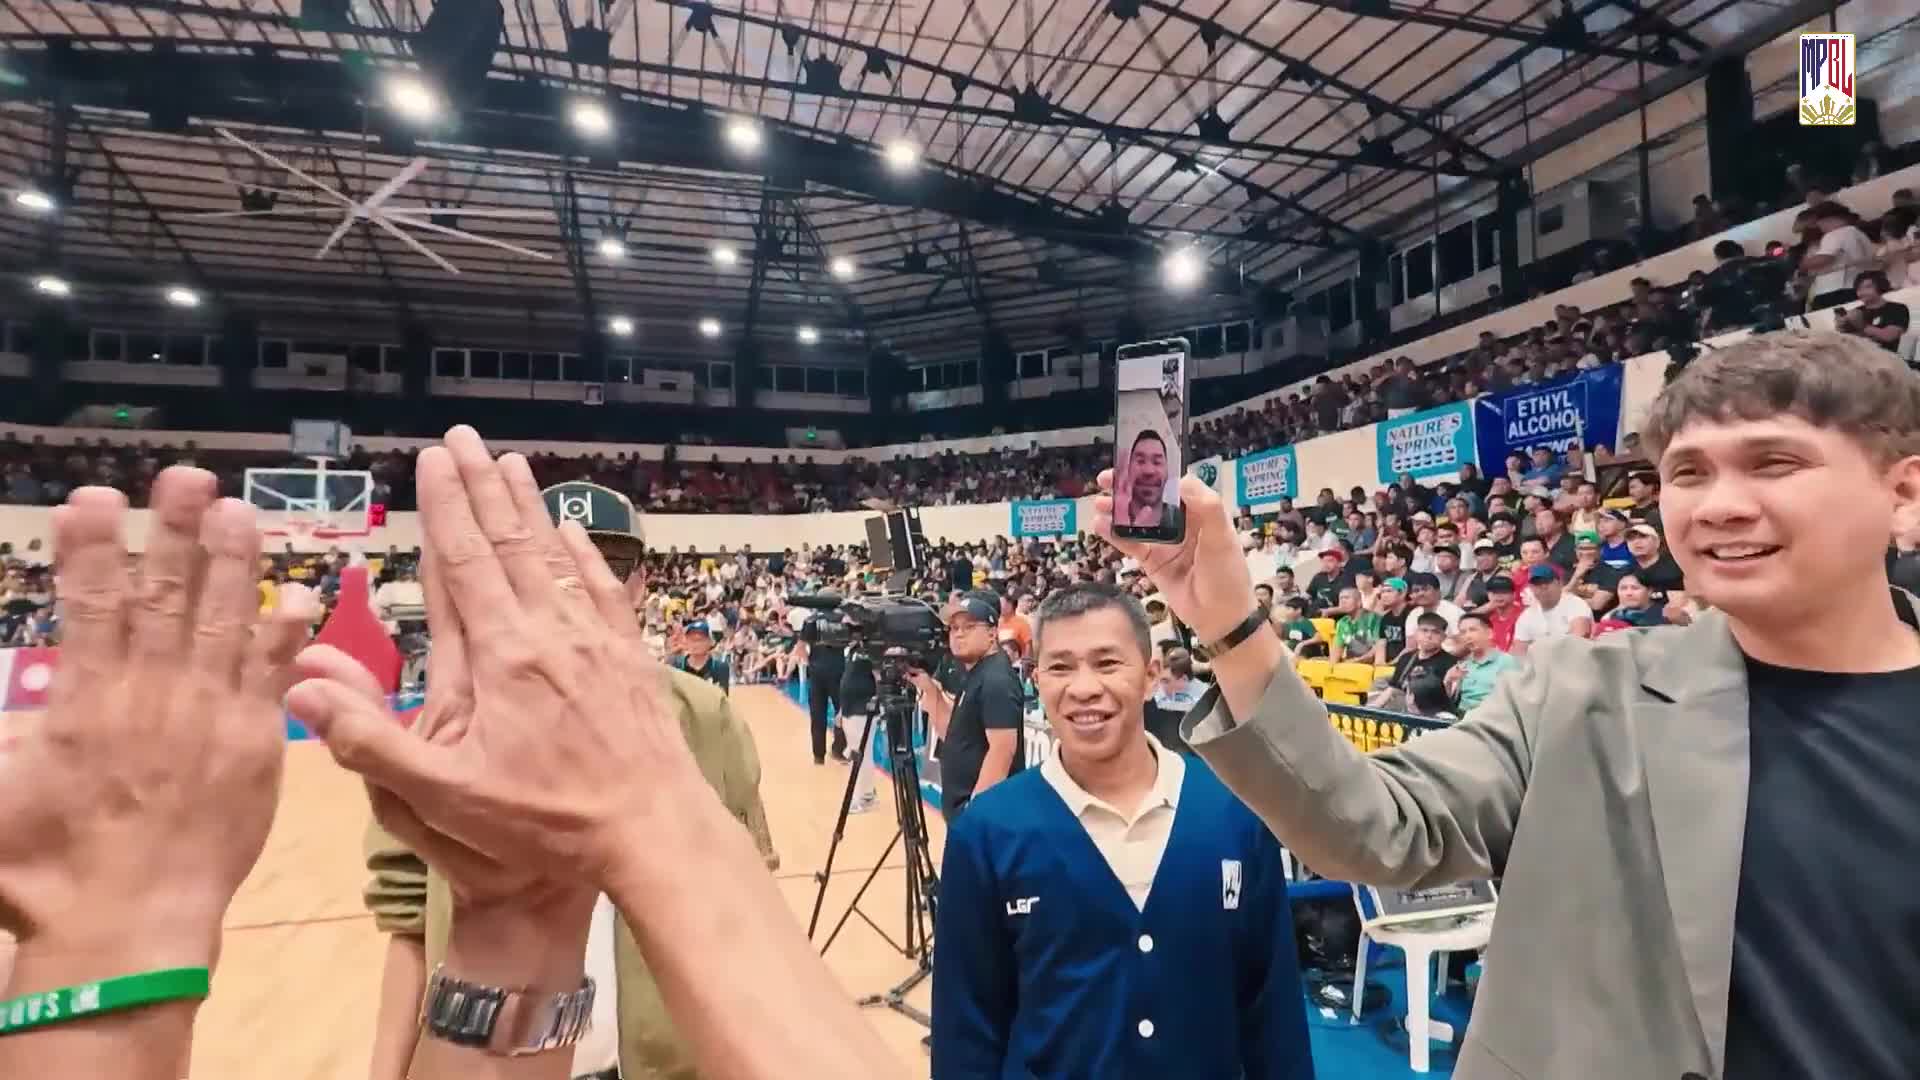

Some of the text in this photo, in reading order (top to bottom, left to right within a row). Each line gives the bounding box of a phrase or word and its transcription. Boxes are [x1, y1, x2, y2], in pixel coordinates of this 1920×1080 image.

[1518, 390, 1572, 418] ETHYL
[1389, 415, 1460, 441] NATURE'S
[1508, 408, 1584, 440] ALCOHOL
[1392, 432, 1452, 455] SPRING
